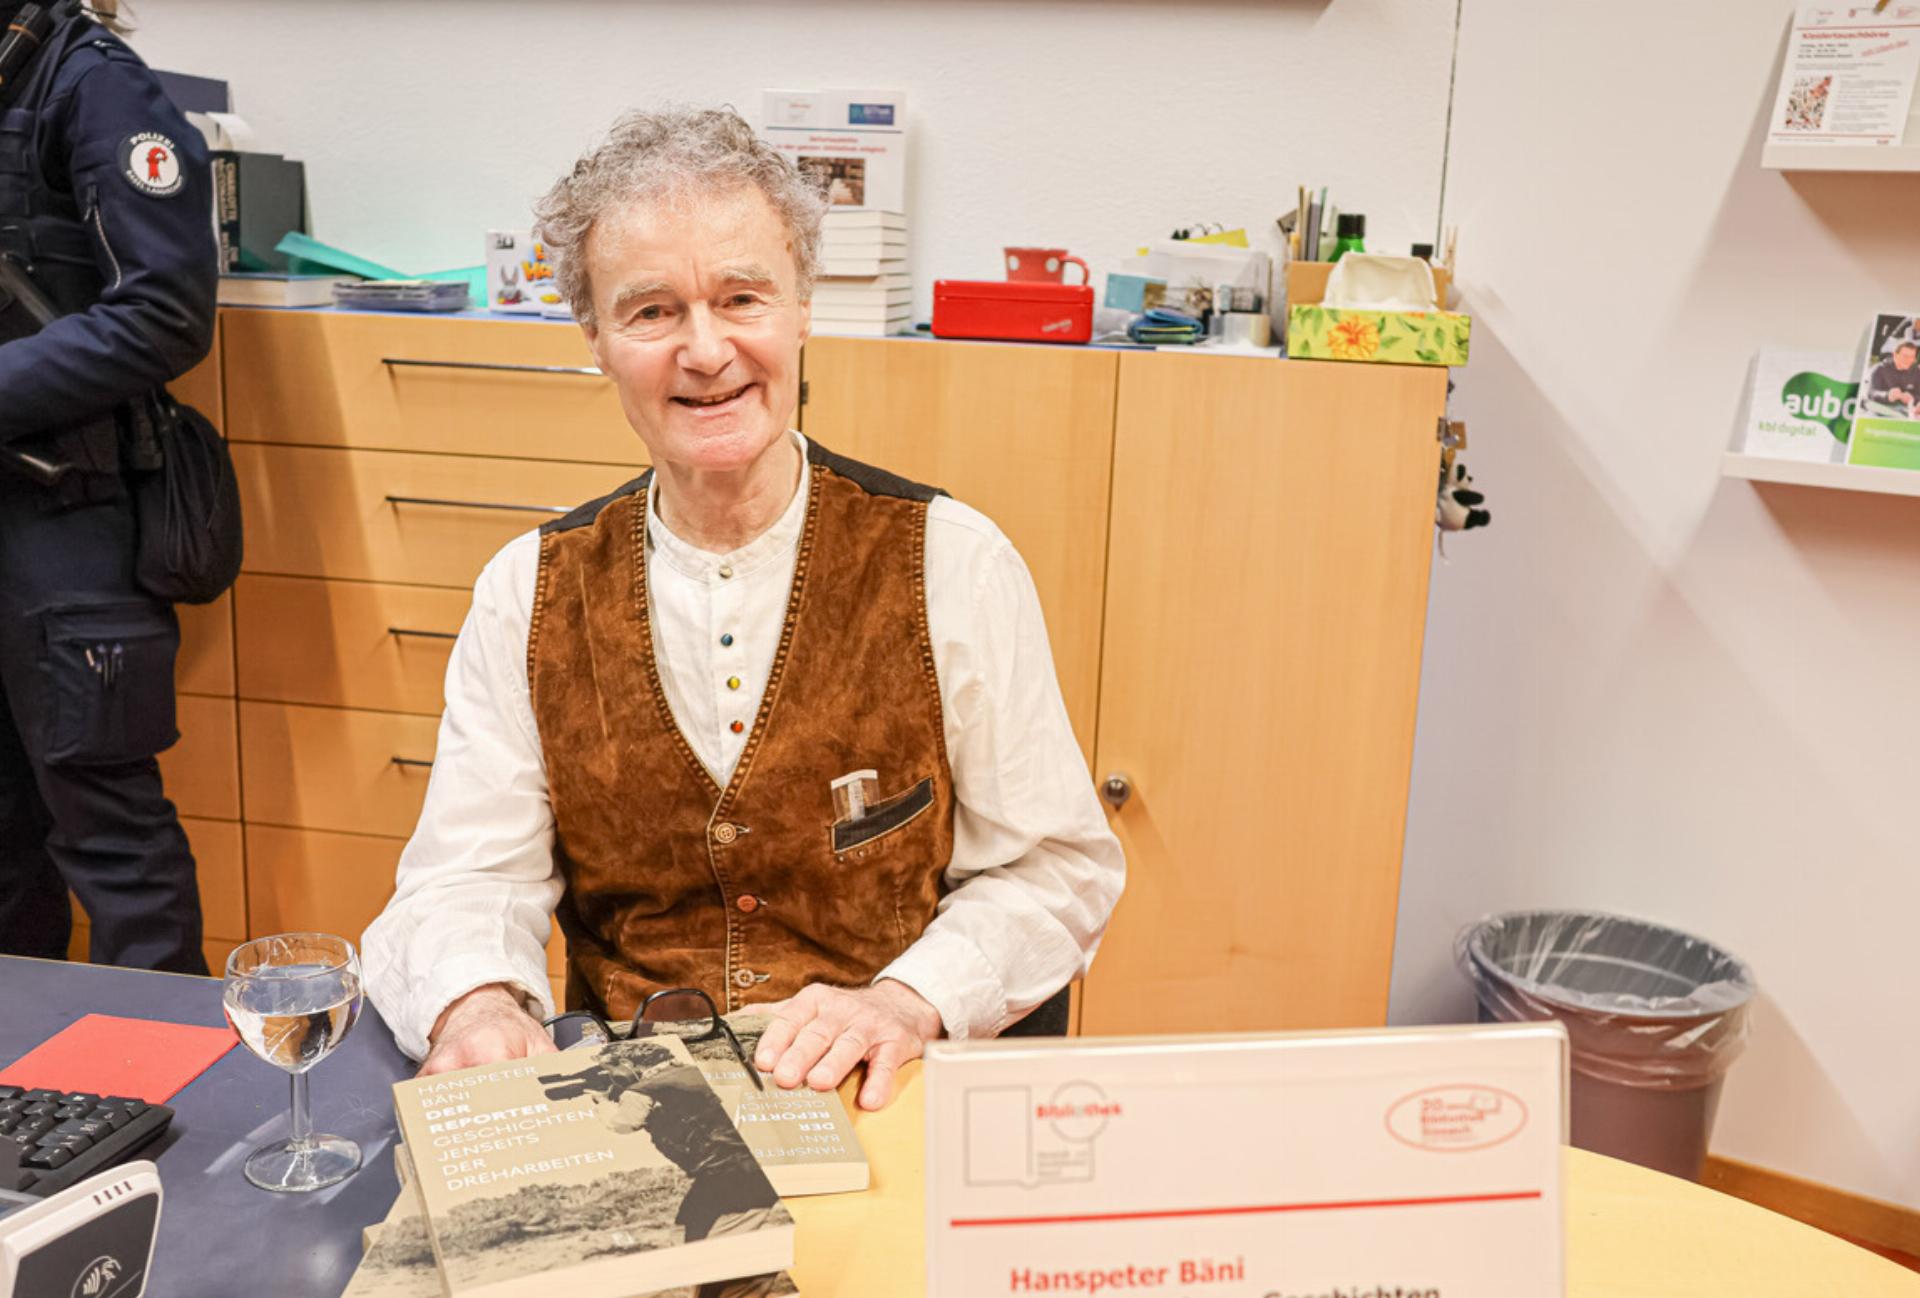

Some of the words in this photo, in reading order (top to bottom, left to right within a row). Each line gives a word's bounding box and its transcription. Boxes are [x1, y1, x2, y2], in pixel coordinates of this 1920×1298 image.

[128, 131, 175, 149] POLIZEI
[1778, 422, 1816, 437] digital
[418, 1066, 538, 1096] HANSPETER
[421, 1091, 471, 1109] BÄNI
[425, 1104, 472, 1121] DER
[428, 1103, 549, 1134] REPORTER
[432, 1109, 595, 1147] GESCHICHTEN
[799, 1122, 835, 1131] DER
[437, 1132, 540, 1162] JENSEITS
[754, 1146, 846, 1158] HANSPETE
[442, 1158, 487, 1177] DER
[446, 1149, 615, 1191] DREHARBEITEN
[1010, 1264, 1168, 1294] Hanspeter
[1179, 1256, 1244, 1284] Bäni
